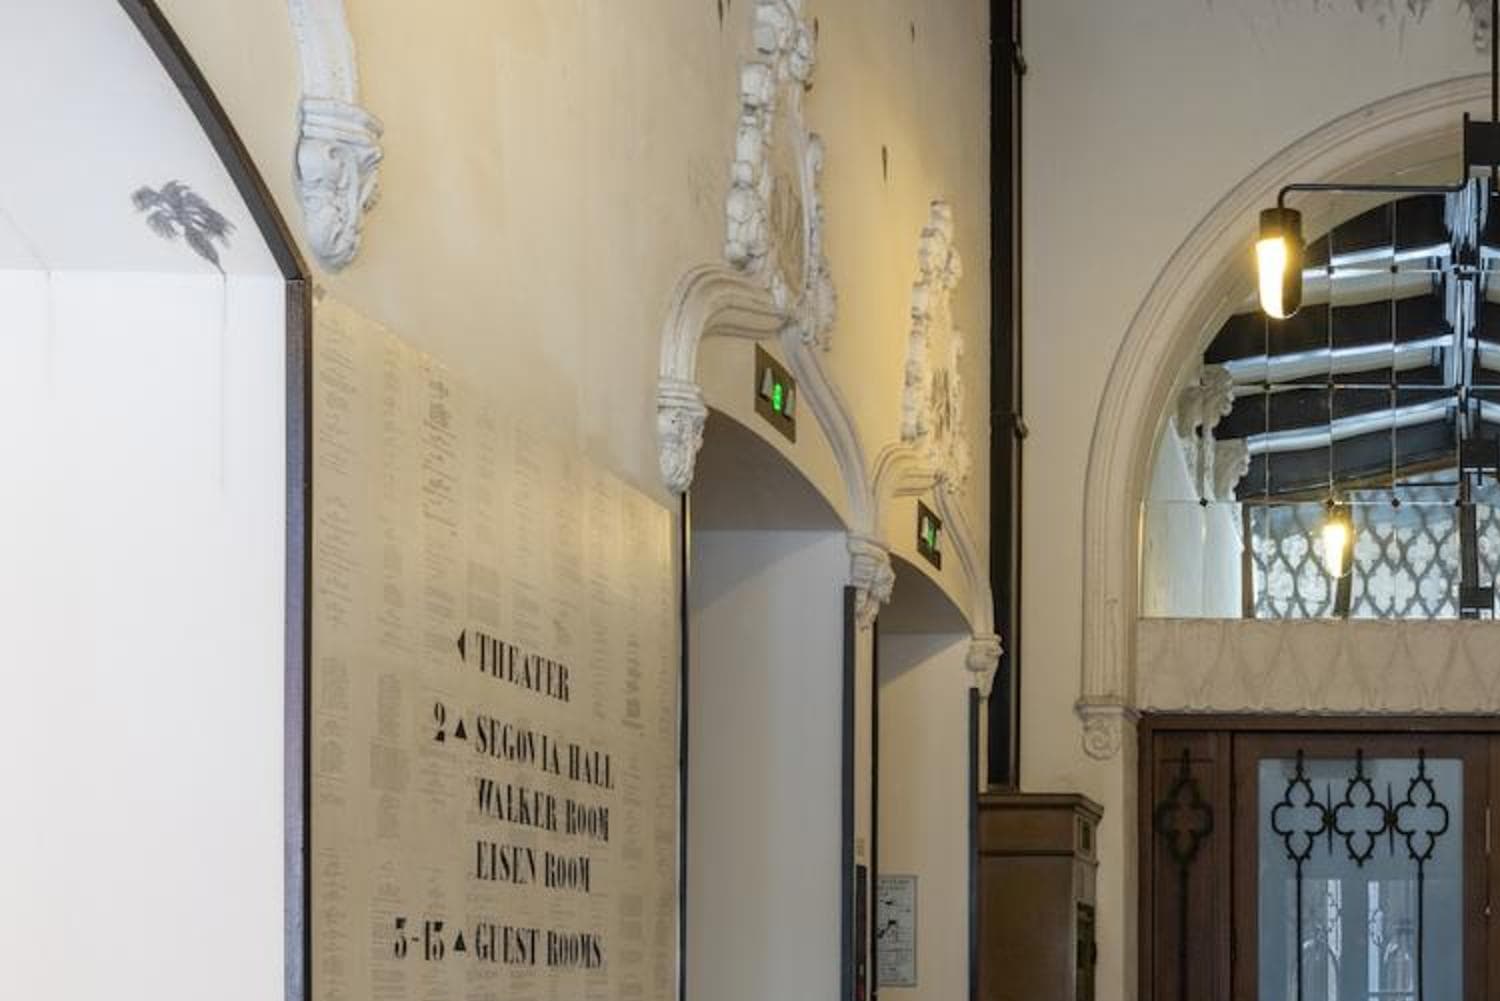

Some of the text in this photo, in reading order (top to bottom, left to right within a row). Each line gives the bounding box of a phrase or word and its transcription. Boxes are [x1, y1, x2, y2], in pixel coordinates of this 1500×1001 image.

[476, 631, 569, 702] THEATER
[434, 702, 614, 789] 2 SEGOVIA HALL
[475, 777, 609, 842] WALKER ROOM
[477, 840, 591, 892] EISEN ROOM
[475, 922, 541, 966] GUEST
[547, 930, 603, 969] ROOMS
